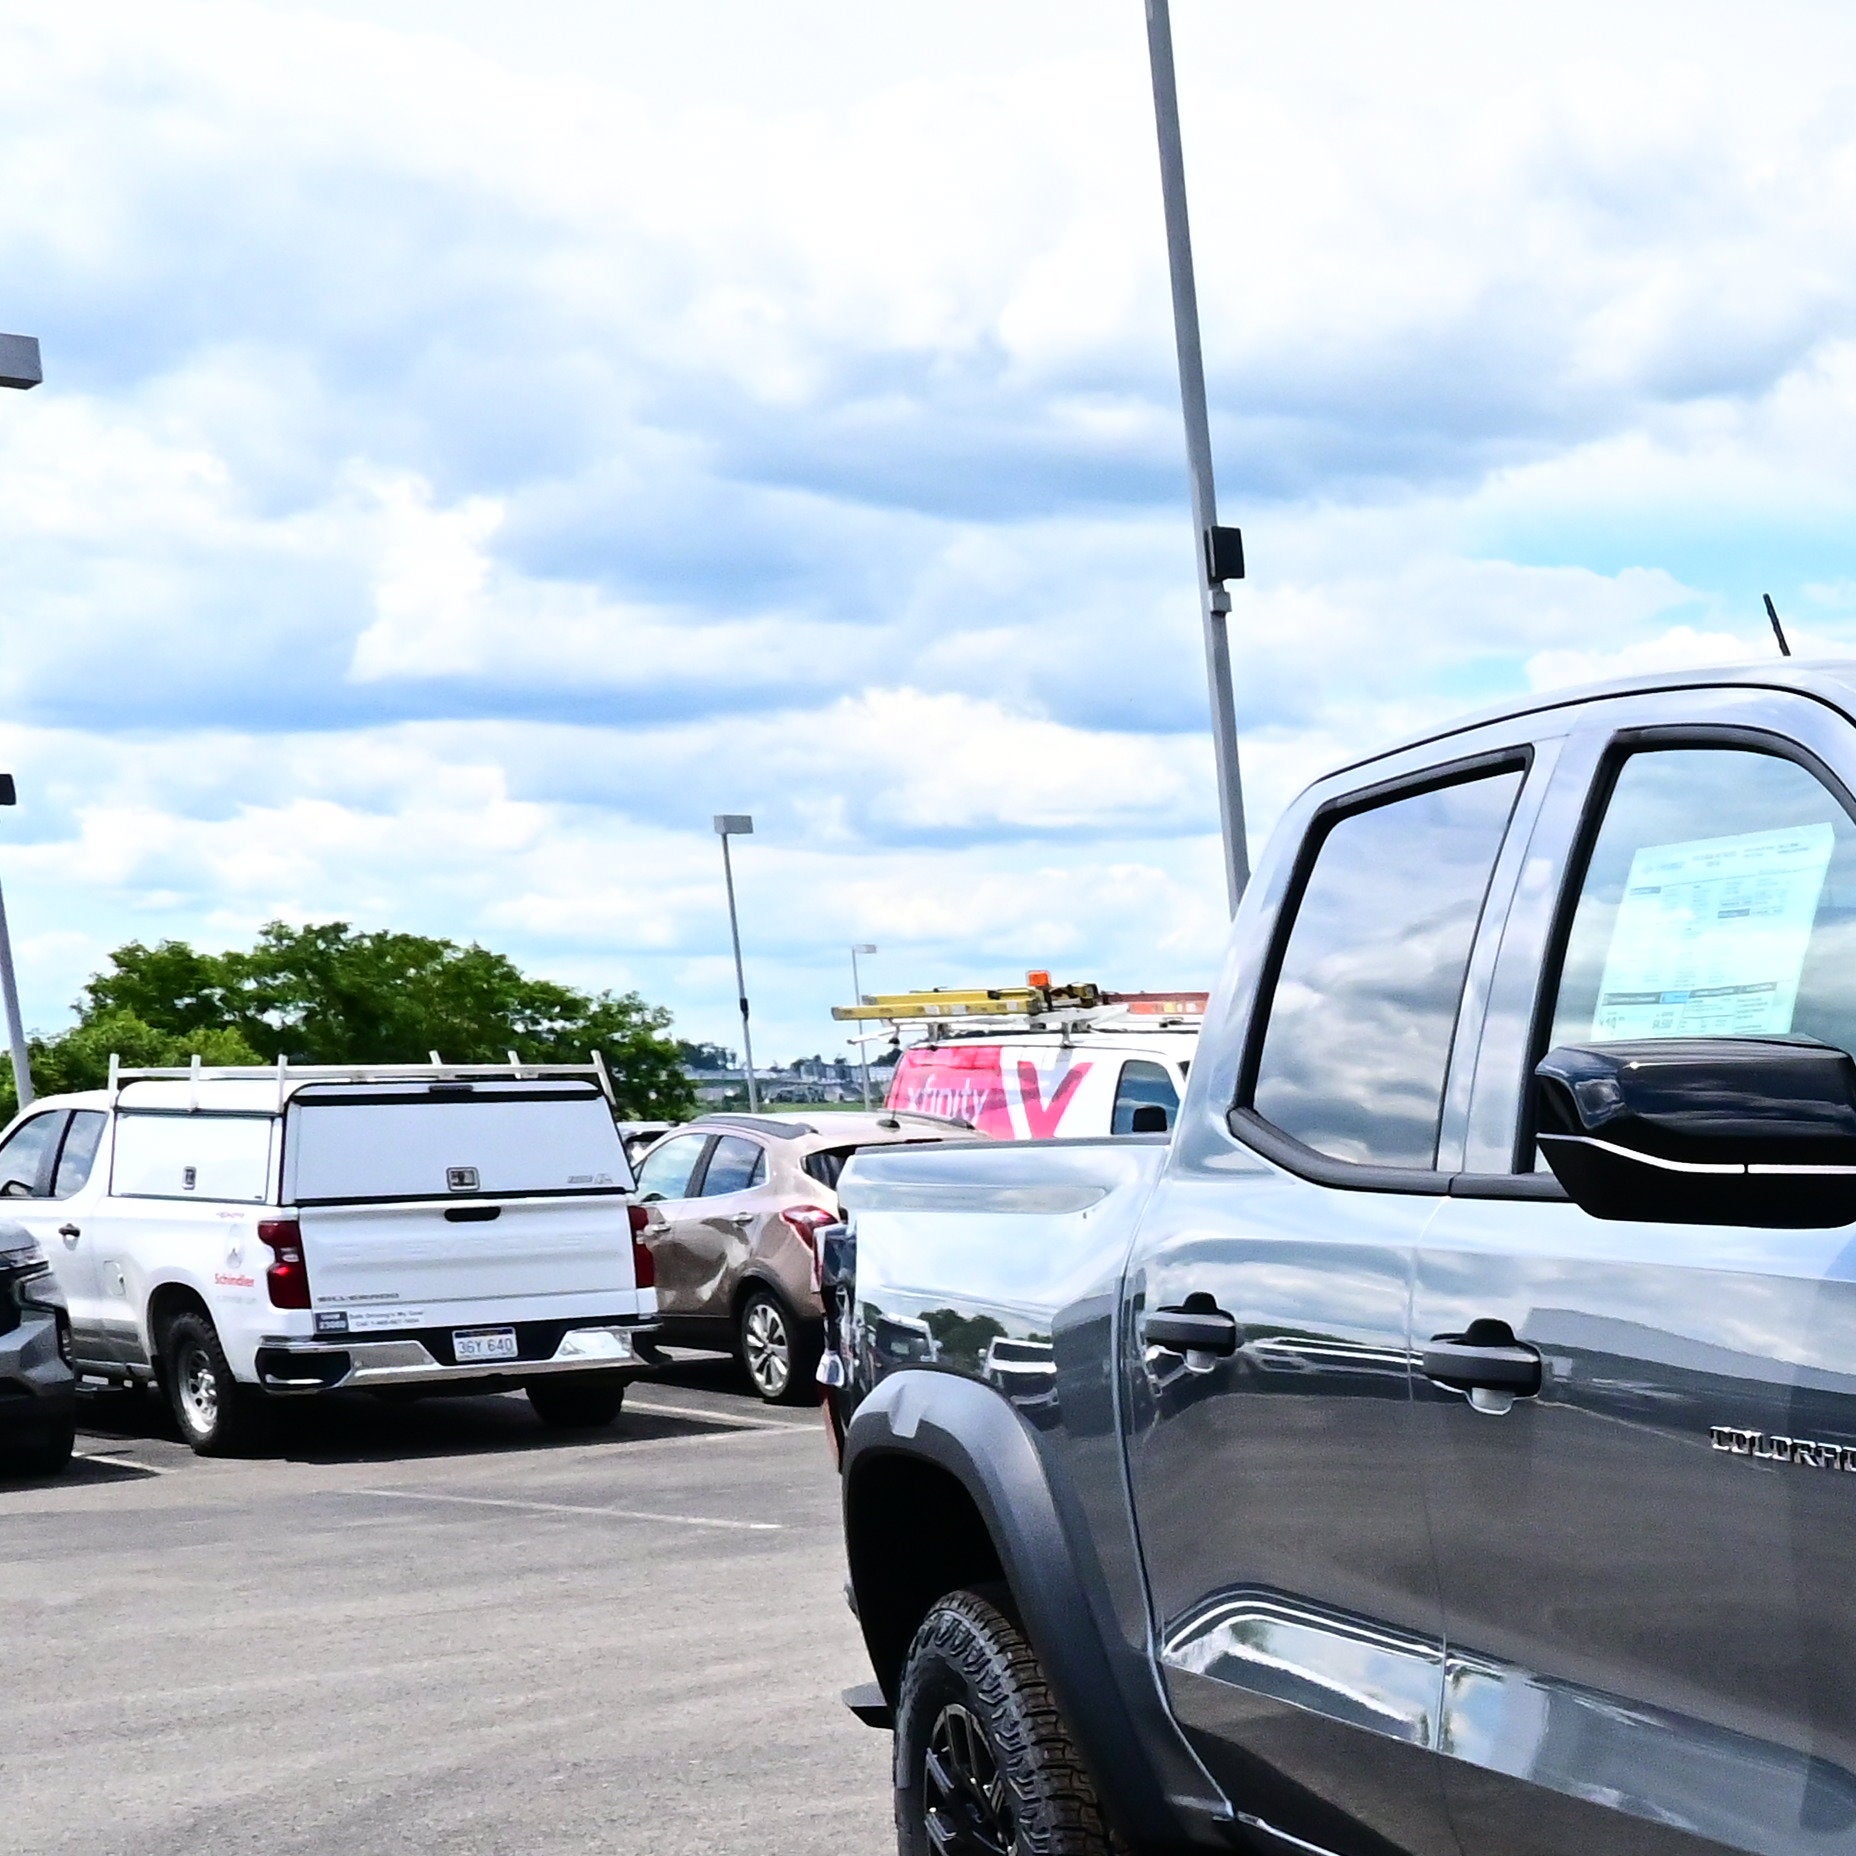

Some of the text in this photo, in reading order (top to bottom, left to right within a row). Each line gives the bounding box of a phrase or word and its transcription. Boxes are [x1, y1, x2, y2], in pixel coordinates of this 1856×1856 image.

[906, 1073, 990, 1126] xfinity
[213, 1272, 255, 1288] Schindler
[487, 1337, 514, 1352] 640
